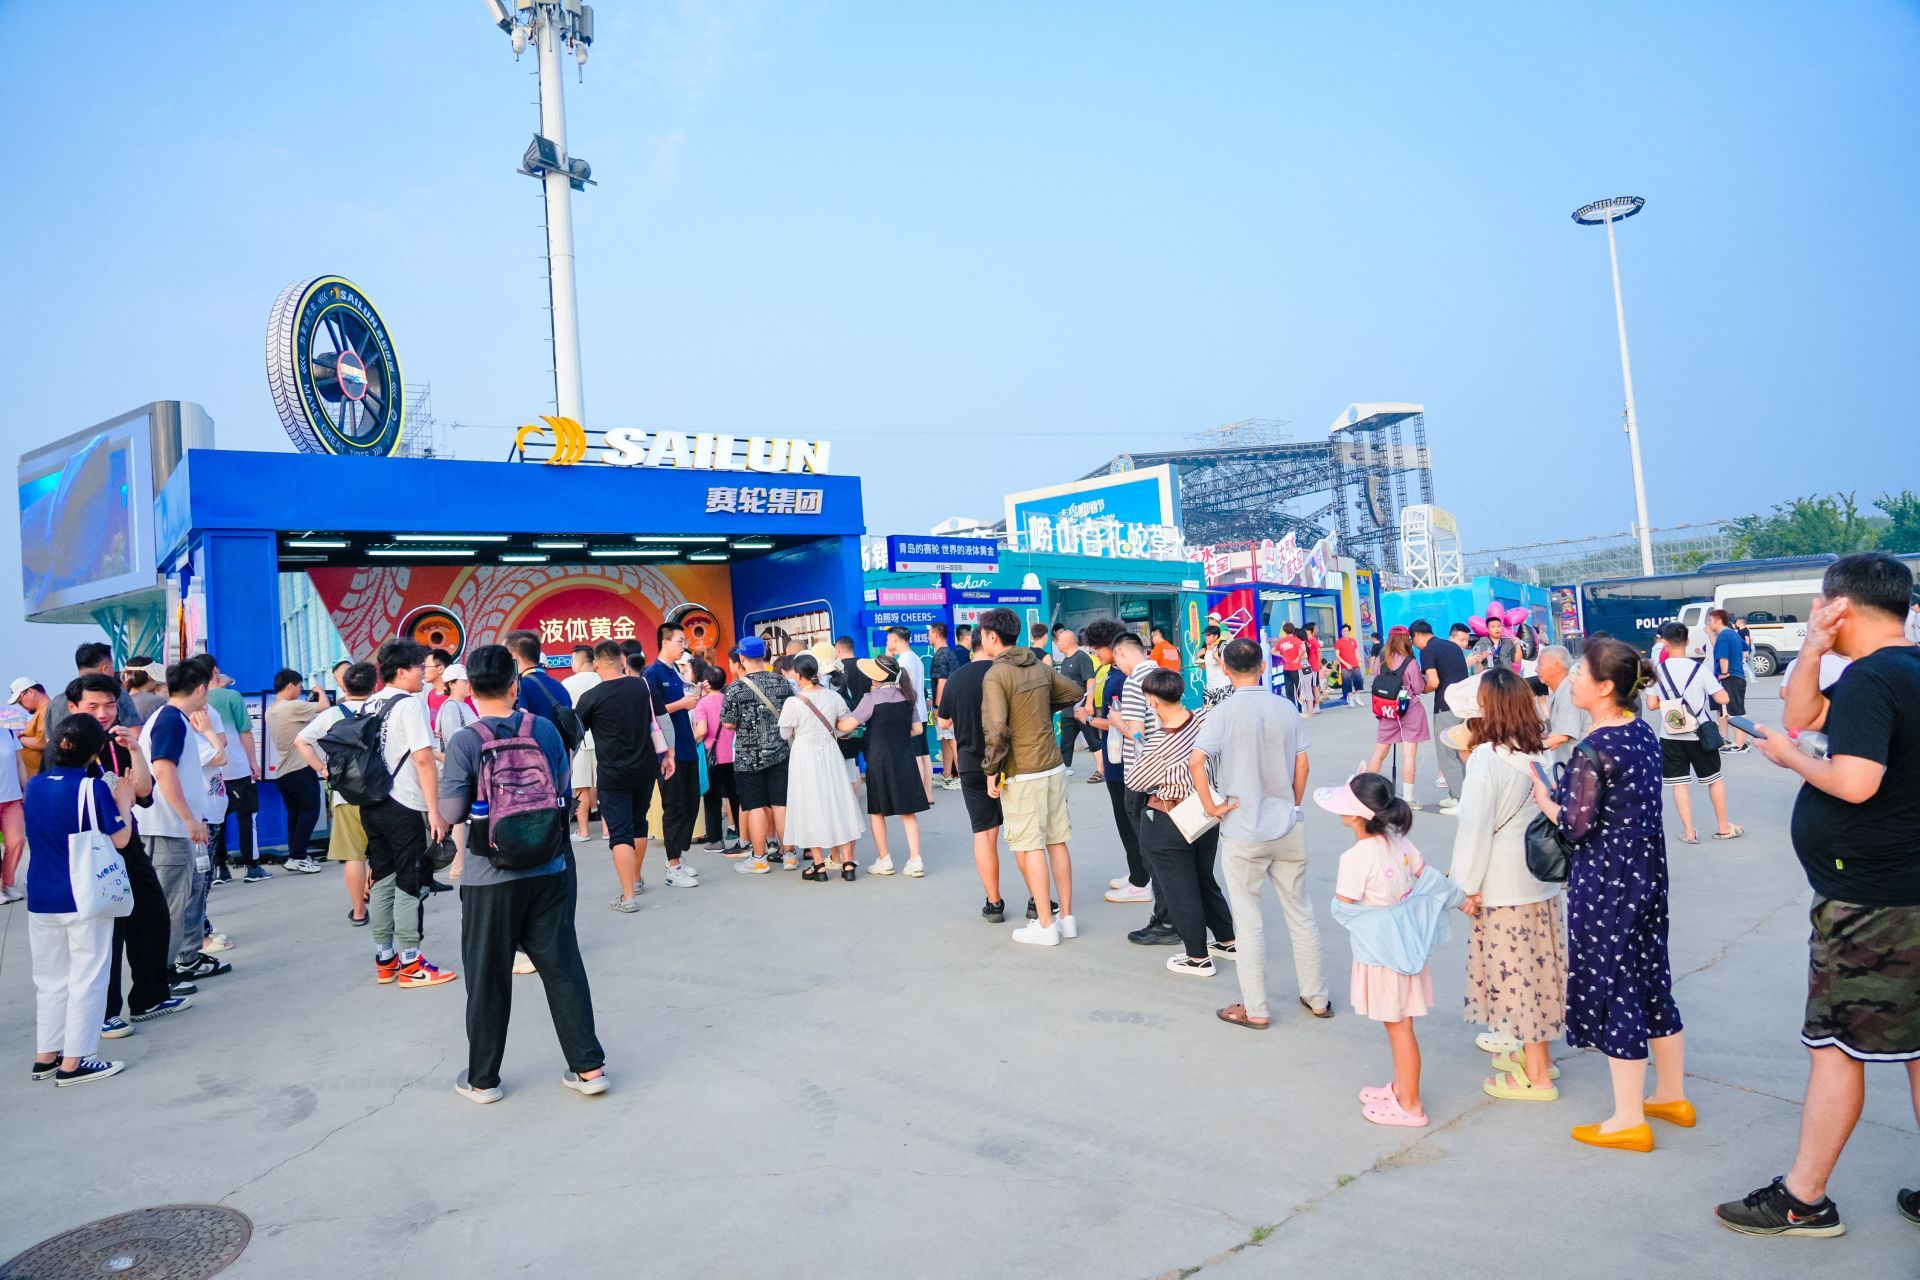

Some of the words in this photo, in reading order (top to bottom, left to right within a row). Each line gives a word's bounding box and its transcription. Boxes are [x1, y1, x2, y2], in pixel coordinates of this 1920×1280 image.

[340, 290, 379, 329] SAILUN
[303, 383, 321, 420] MAKE
[321, 423, 346, 453] GREAT
[601, 427, 830, 475] SAILUN
[705, 486, 824, 515] 赛轮集团
[899, 542, 940, 555] 青岛的赛轮
[941, 544, 995, 557] 世界的液体黄金
[539, 615, 637, 644] 液体黄金
[874, 612, 899, 624] 拍照呀
[901, 612, 937, 622] CHEERS~
[96, 861, 120, 881] MORE
